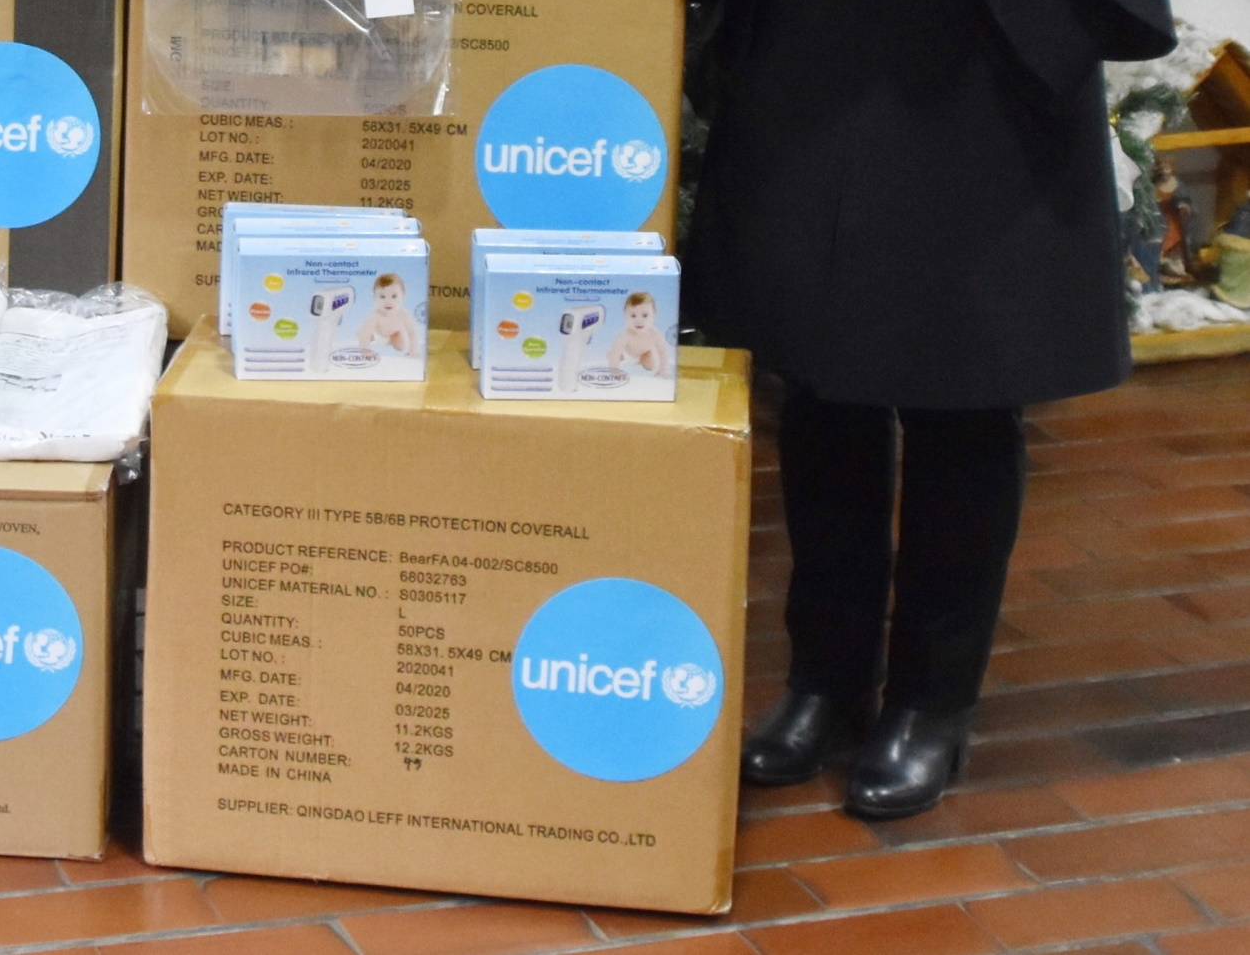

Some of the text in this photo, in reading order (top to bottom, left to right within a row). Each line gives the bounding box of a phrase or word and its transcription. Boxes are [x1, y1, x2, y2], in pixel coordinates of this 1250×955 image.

[467, 2, 539, 18] COVERALL
[199, 150, 411, 172] MFG. DATE: 04/2020
[483, 135, 607, 179] unicef
[287, 268, 320, 276] Infrared
[223, 503, 304, 519] CATEGORY
[308, 507, 322, 521] III
[323, 509, 363, 523] TYPE
[409, 515, 507, 533] PROTECTION
[510, 521, 590, 540] COVERALL
[222, 559, 277, 574] UNICEF
[399, 570, 467, 586] 68032763
[220, 668, 450, 698] MFG. DATE: 04/2020
[521, 653, 656, 701] unicef
[219, 691, 450, 719] EXP. DATE: 03/2025
[219, 710, 454, 739] NET WEIGHT: 11.2KGS
[219, 728, 454, 758] GROSS WEIGHT: 12.2KGS
[218, 763, 332, 784] MADE IN CHINA
[218, 798, 293, 817] SUPPLIER:
[297, 803, 364, 823] QINGDAO
[368, 809, 403, 825] LEFF
[407, 814, 524, 836] INTERNATIONAL
[528, 825, 593, 844] TRADING
